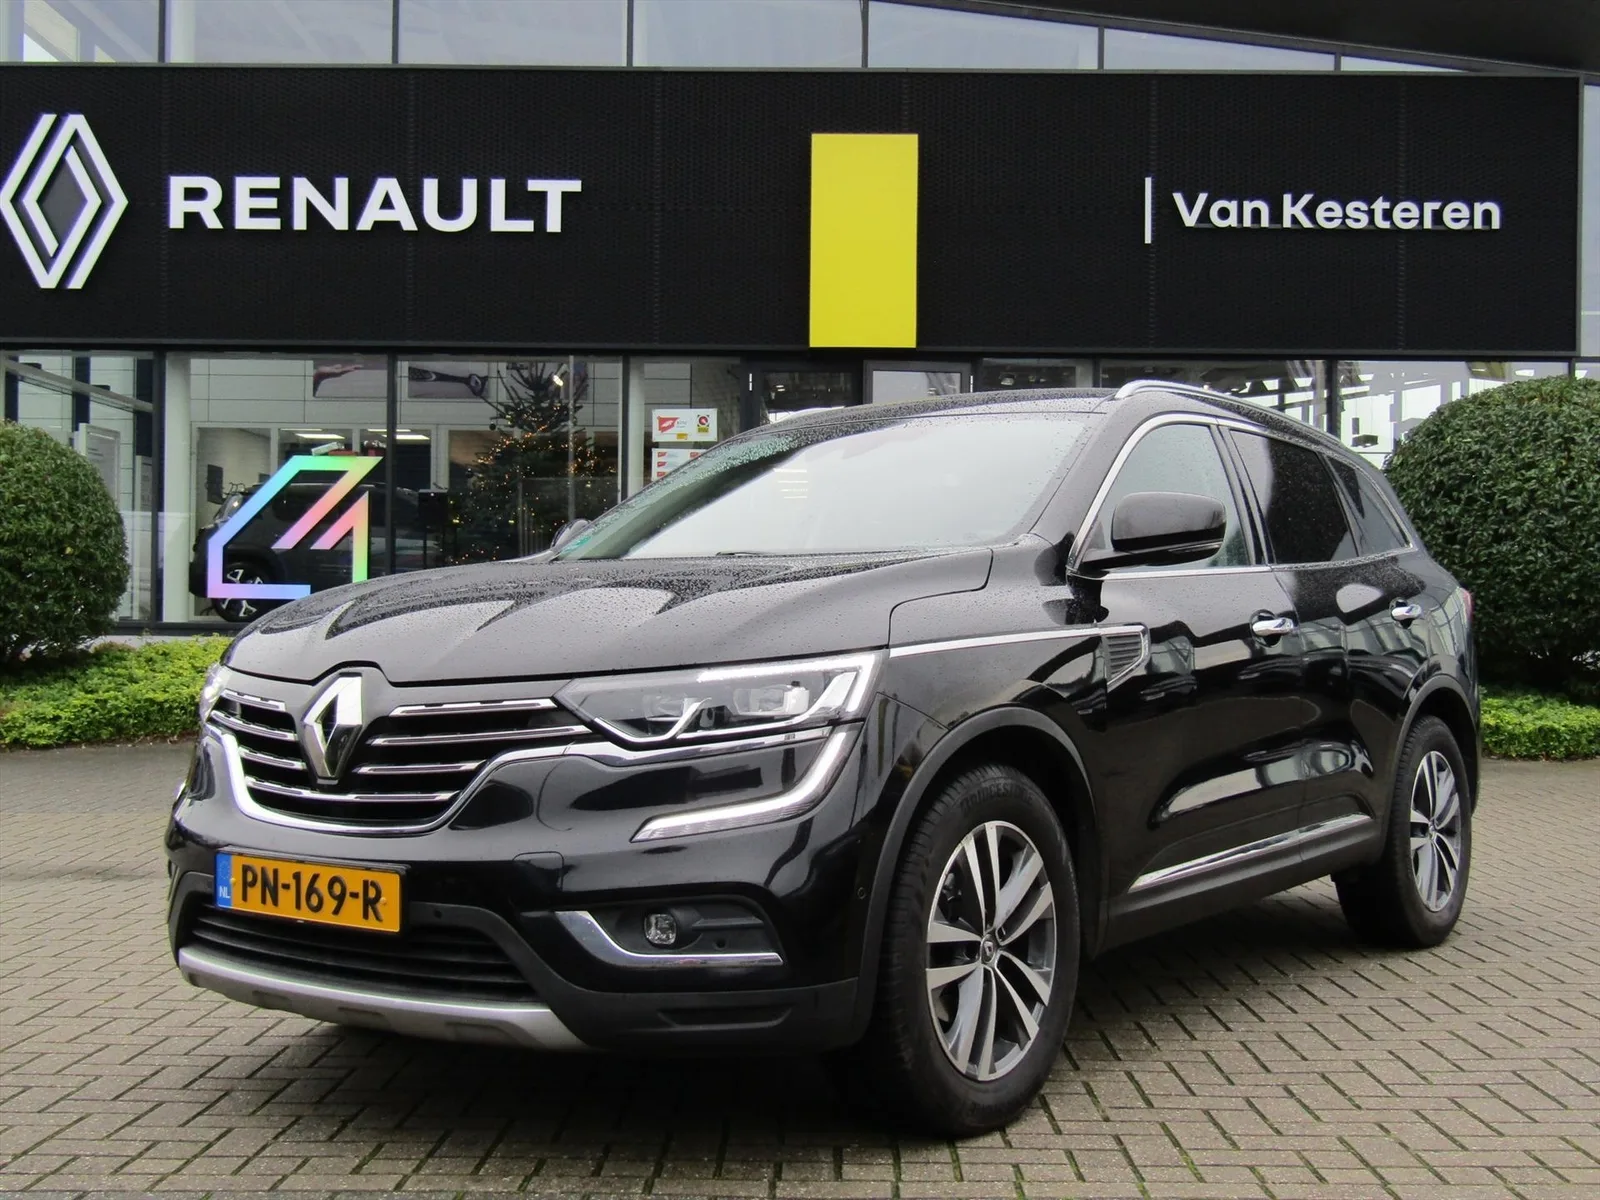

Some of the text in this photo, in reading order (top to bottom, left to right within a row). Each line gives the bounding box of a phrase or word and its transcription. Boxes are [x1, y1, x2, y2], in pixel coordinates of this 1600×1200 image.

[168, 175, 582, 234] RENAULT
[1172, 192, 1501, 230] Van Kesteren
[219, 886, 231, 899] NL
[241, 864, 383, 922] PN-169-R
